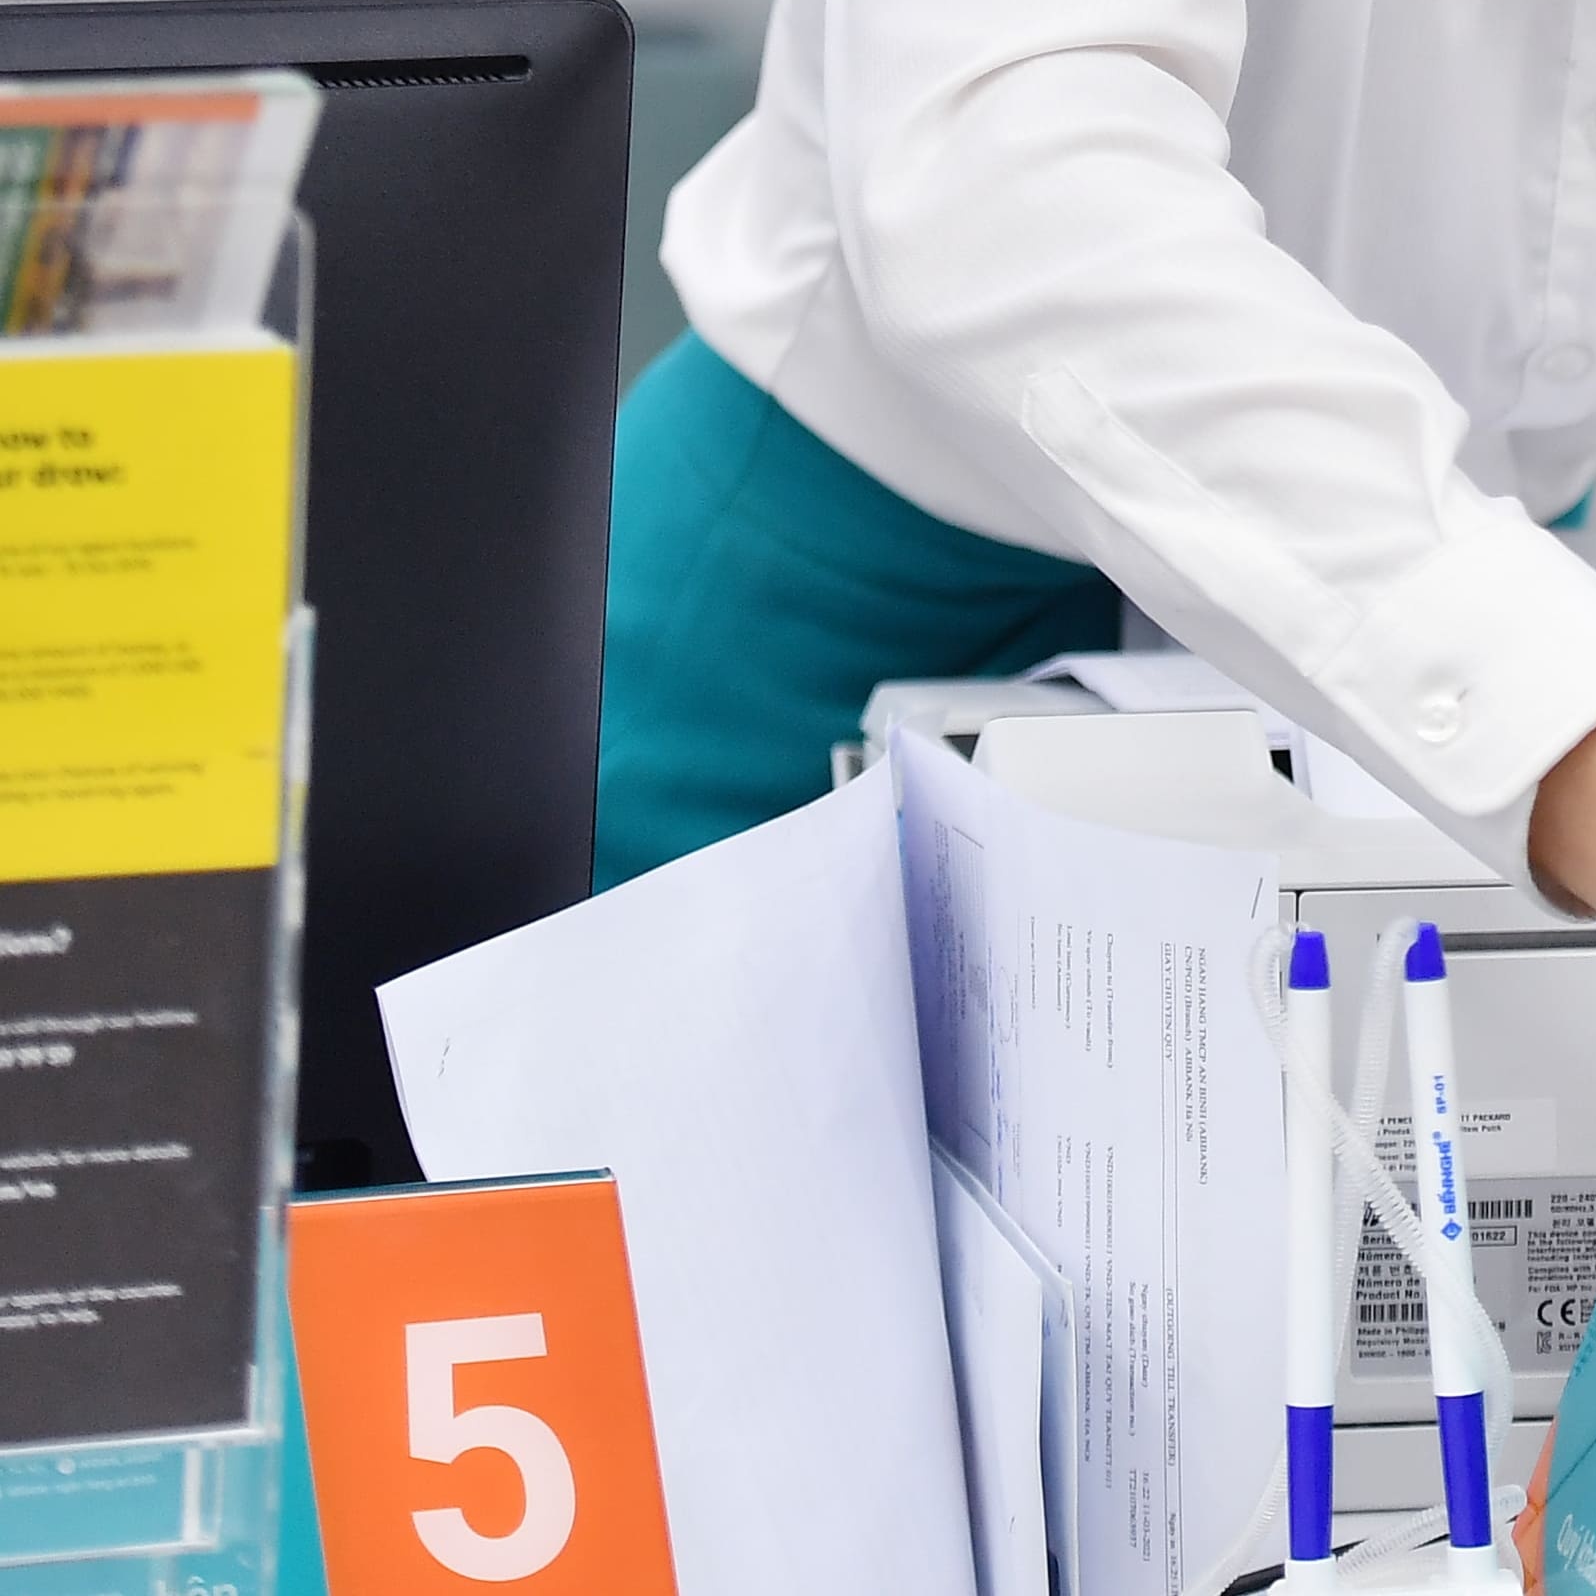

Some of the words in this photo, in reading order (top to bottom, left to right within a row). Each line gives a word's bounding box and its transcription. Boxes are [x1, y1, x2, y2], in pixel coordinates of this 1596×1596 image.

[1473, 1113, 1511, 1122] PACKARD
[1356, 1290, 1401, 1301] Product
[404, 1312, 577, 1583] 5
